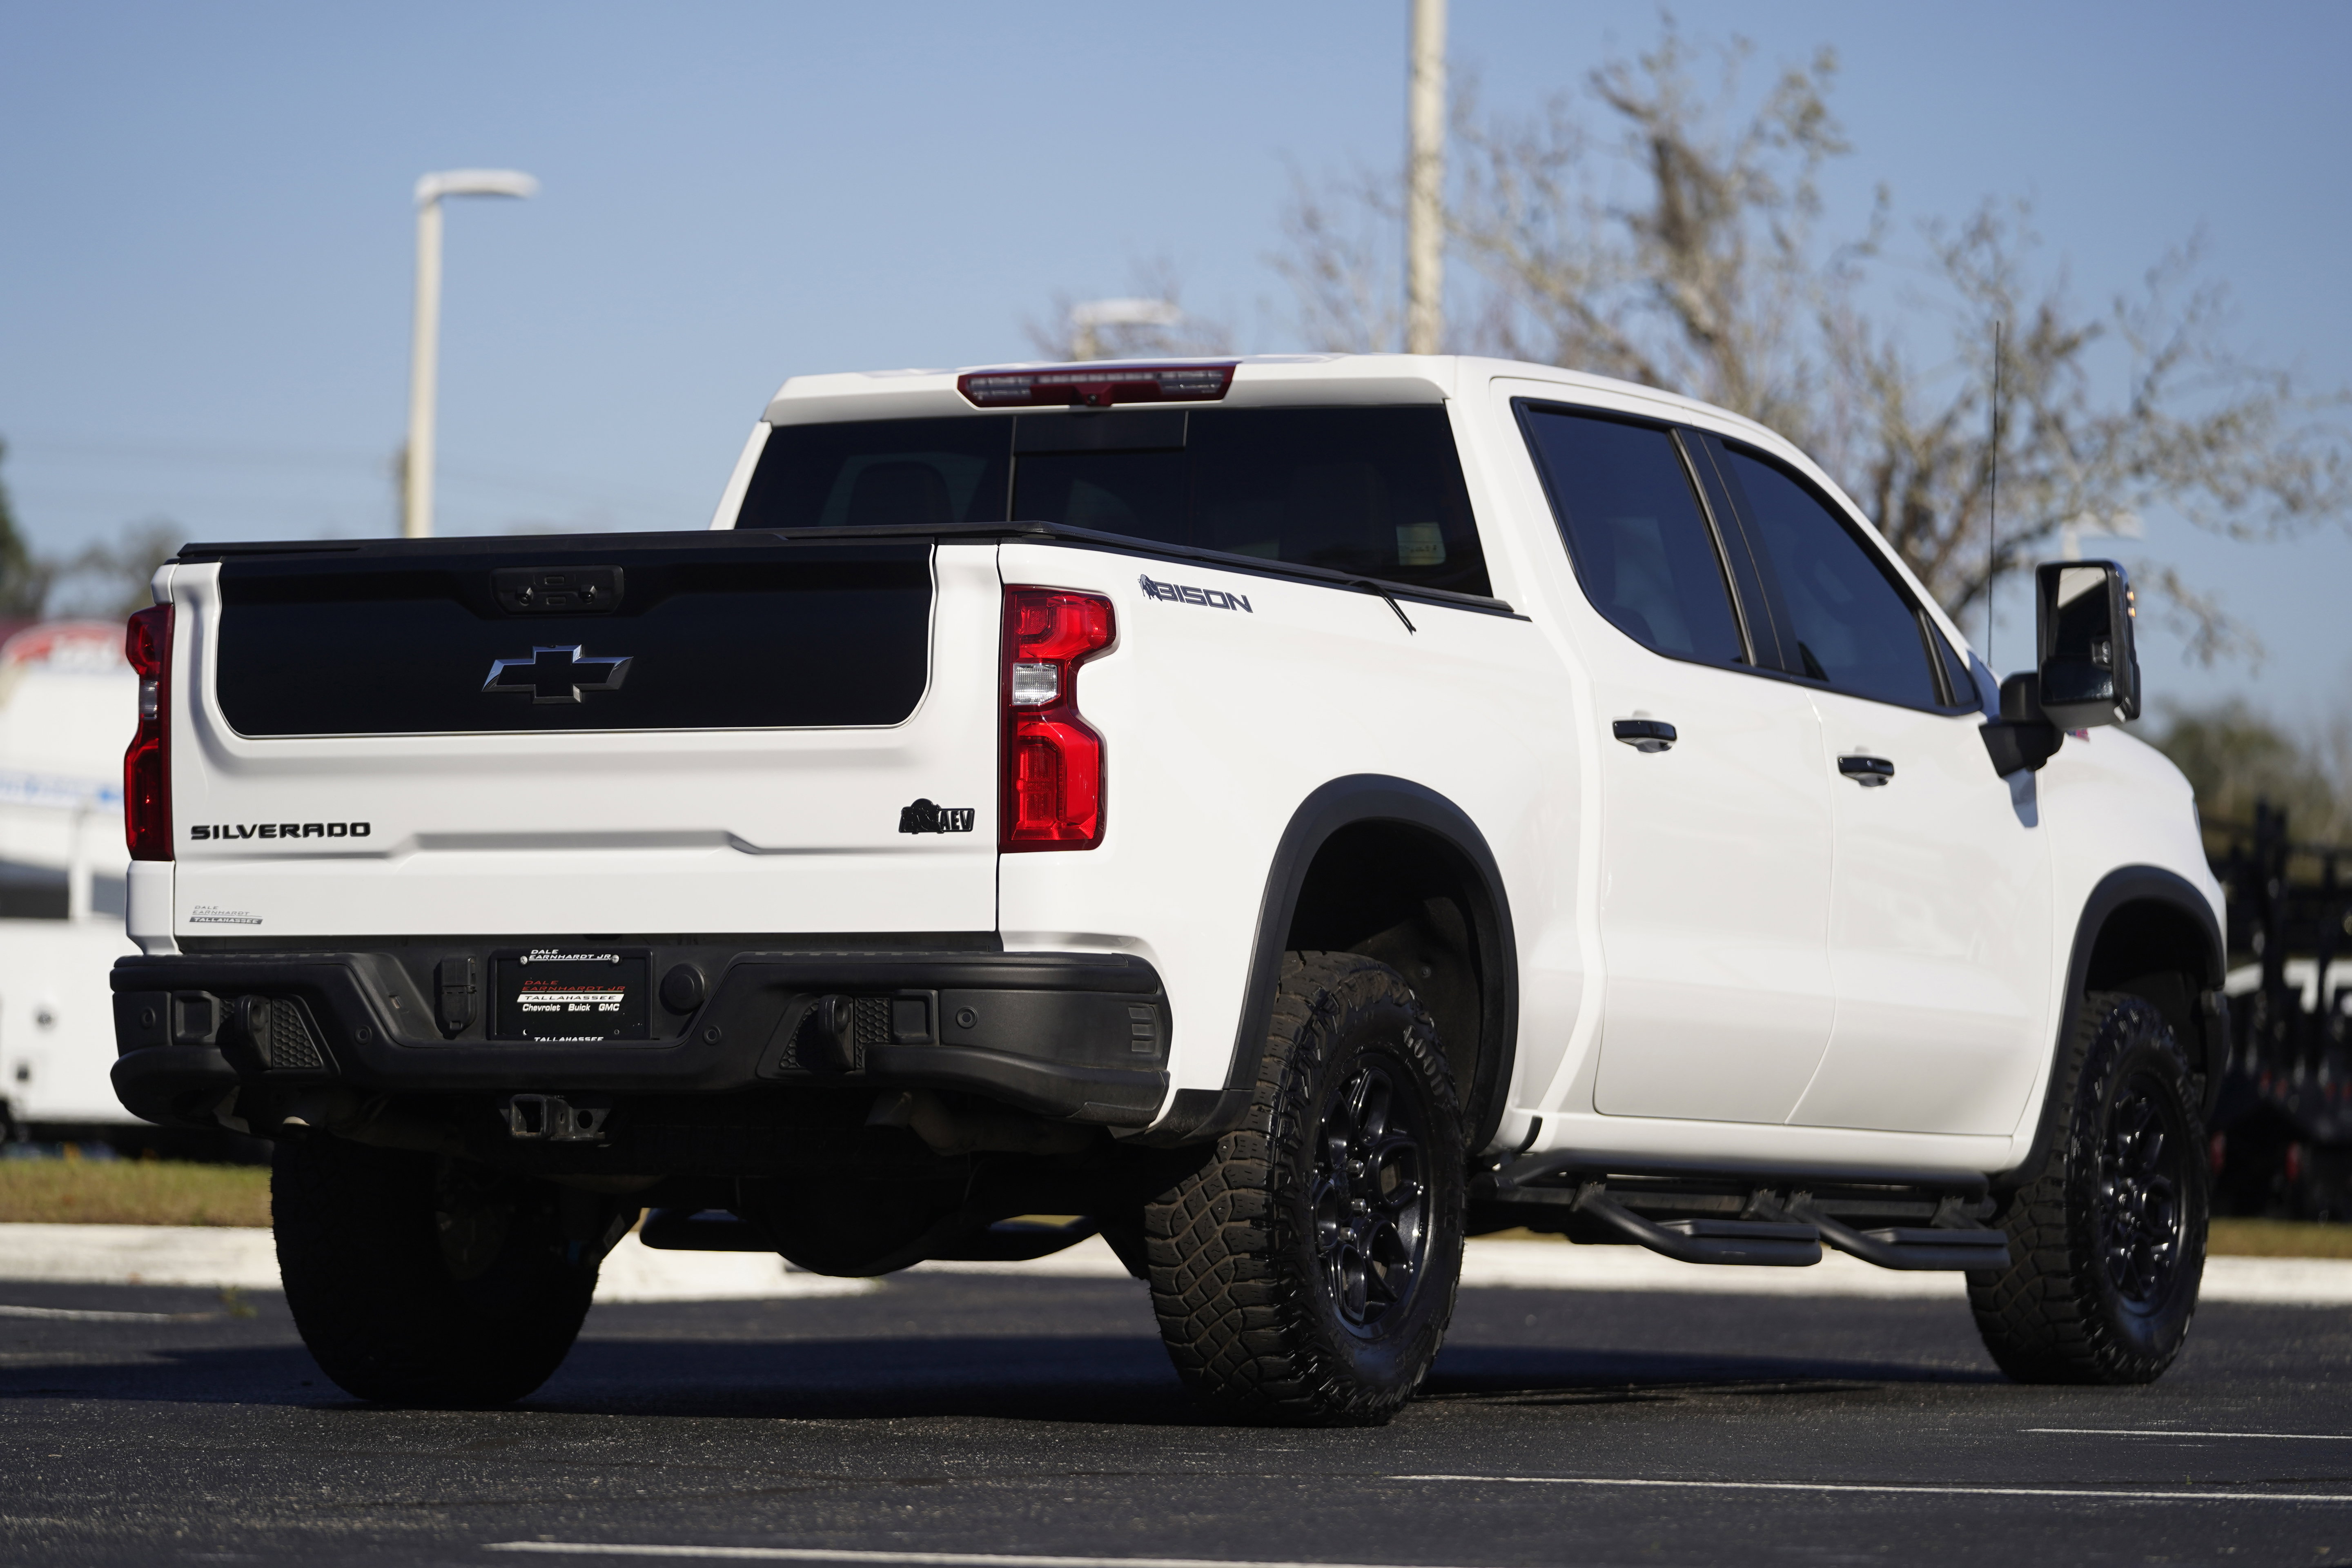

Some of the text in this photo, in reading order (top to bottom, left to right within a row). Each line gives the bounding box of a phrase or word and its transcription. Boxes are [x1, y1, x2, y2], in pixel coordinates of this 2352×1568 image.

[1153, 580, 1254, 613] BISON
[940, 810, 973, 830] AEV
[191, 822, 371, 840] SILVERADO
